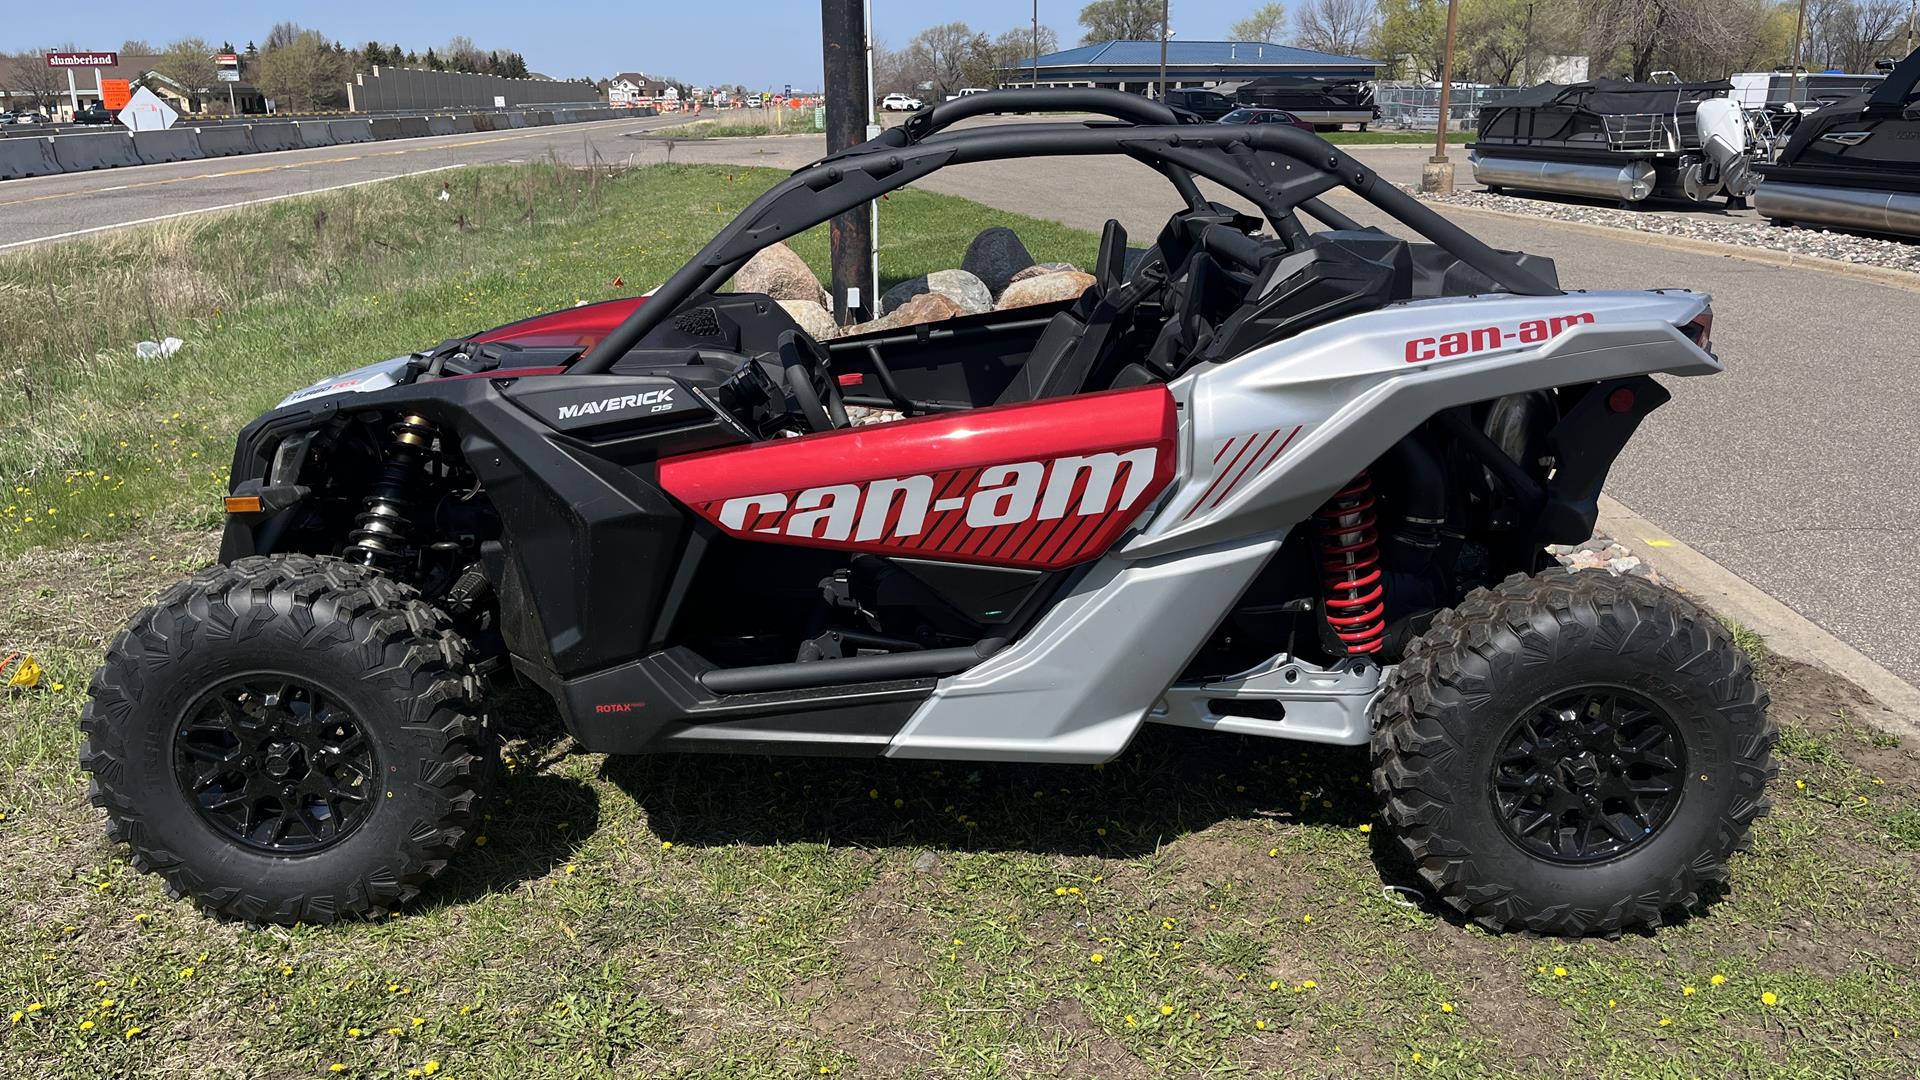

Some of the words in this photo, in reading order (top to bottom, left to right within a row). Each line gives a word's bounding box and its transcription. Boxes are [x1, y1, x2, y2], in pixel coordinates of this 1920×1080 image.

[50, 54, 112, 65] slumberland
[558, 388, 675, 419] MAVERICK
[651, 403, 673, 412] DS
[718, 446, 1158, 542] can-am
[595, 703, 631, 712] ROTAX
